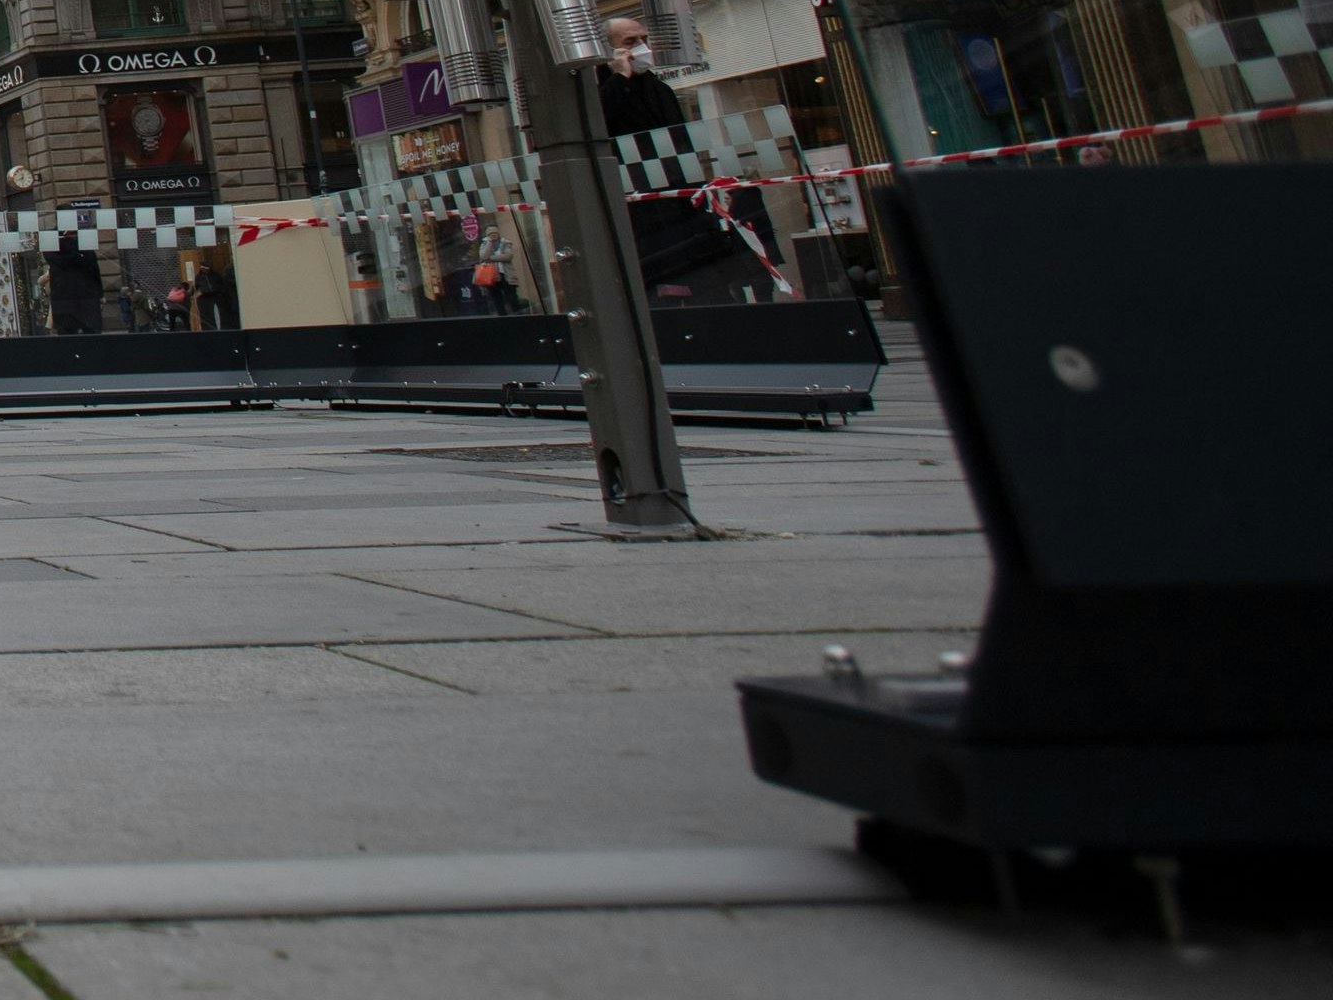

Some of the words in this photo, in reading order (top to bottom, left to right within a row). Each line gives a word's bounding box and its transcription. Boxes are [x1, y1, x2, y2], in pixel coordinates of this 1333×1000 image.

[107, 50, 188, 72] OMEGA
[436, 141, 461, 156] HONEY
[141, 178, 185, 191] OMEGA
